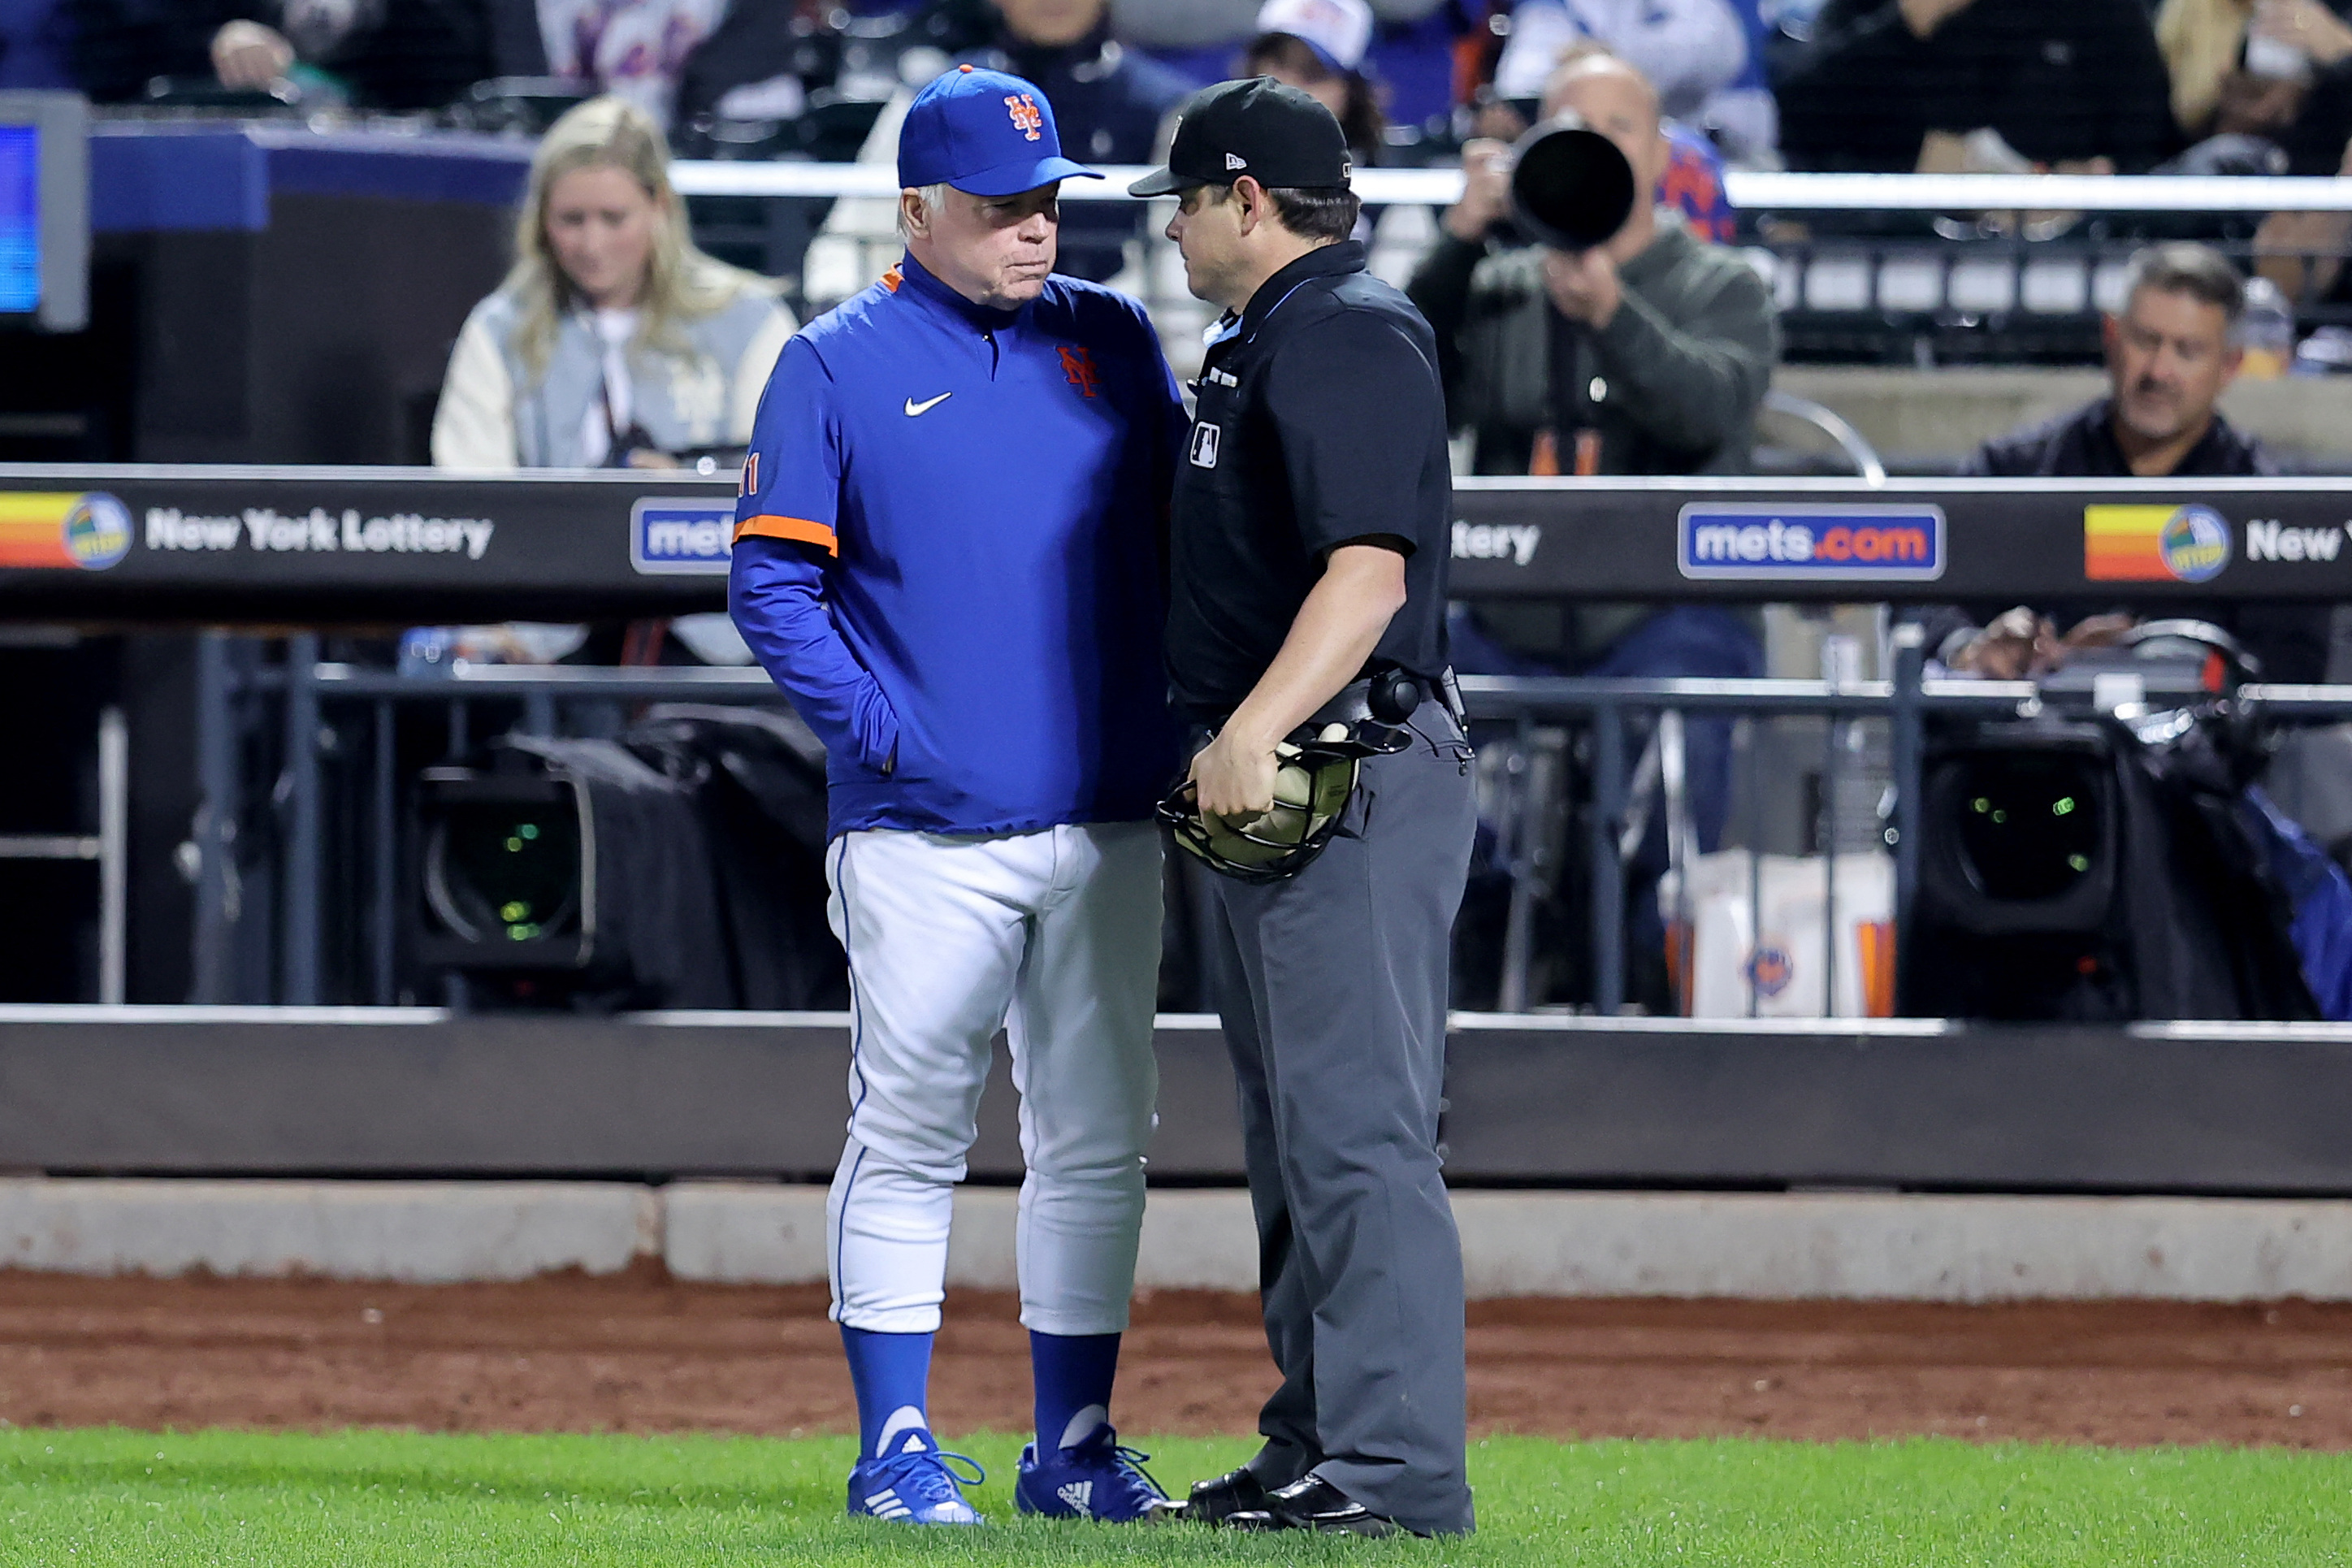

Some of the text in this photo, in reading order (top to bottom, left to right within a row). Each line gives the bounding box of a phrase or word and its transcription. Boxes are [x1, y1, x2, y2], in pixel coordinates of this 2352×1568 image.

[1003, 93, 1042, 141] NY
[1056, 346, 1101, 397] NY
[145, 508, 241, 551] New
[243, 507, 339, 551] York
[341, 509, 494, 560] Lottery
[1695, 518, 1929, 561] mets.com
[2245, 518, 2343, 562] New
